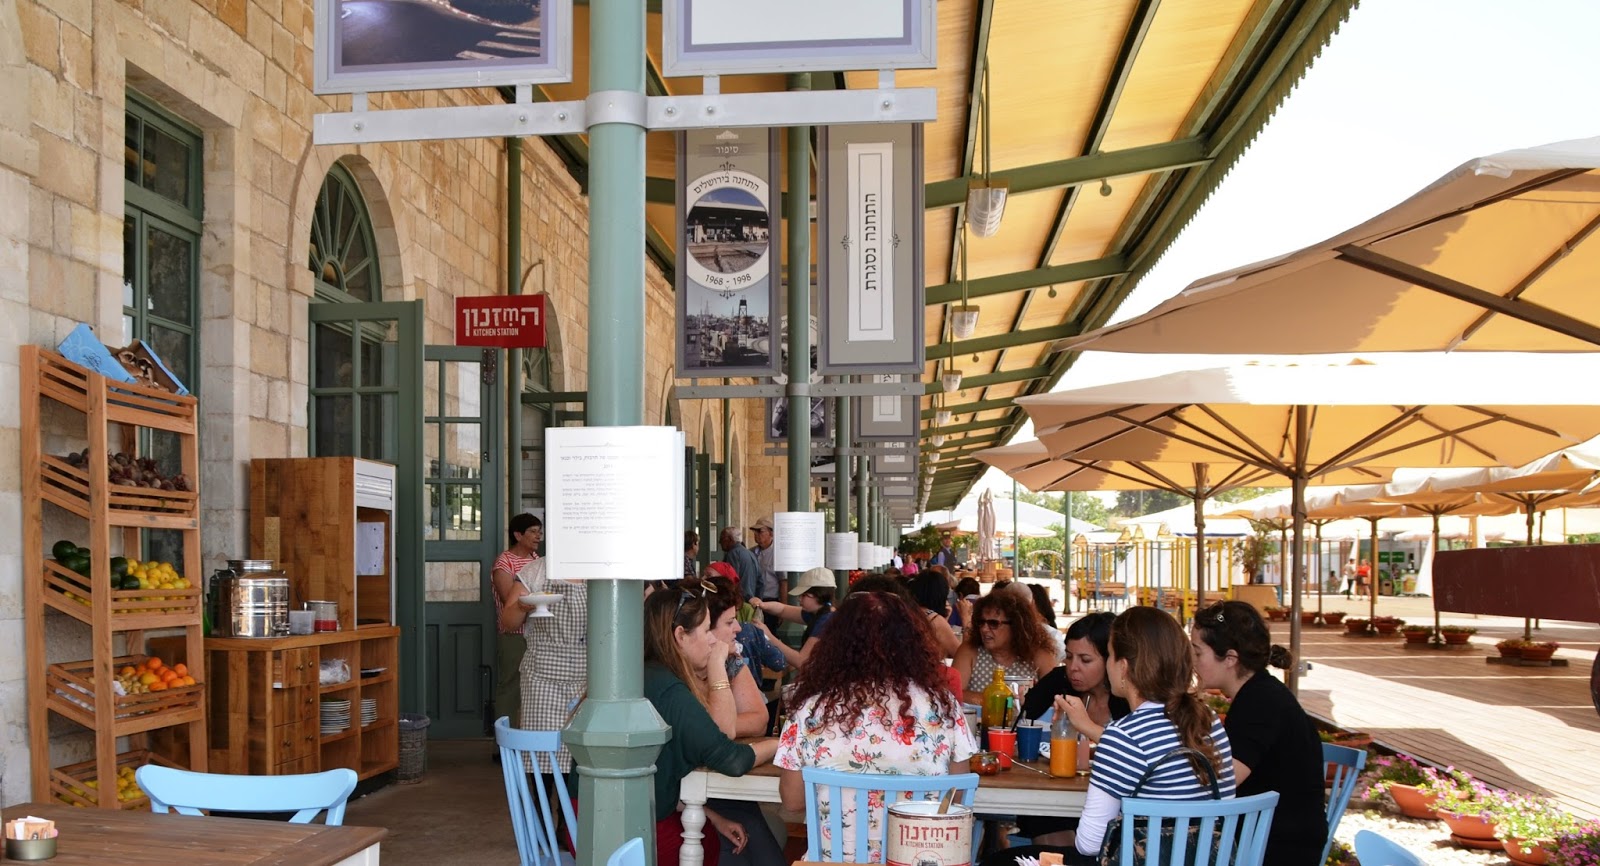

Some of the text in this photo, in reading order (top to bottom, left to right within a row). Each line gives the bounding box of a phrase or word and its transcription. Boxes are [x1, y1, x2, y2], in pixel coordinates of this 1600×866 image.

[715, 146, 739, 154] סיפור
[693, 175, 759, 194] התחנה בירושלים
[865, 193, 876, 291] התחנה נסגרת
[705, 274, 723, 285] 1968
[733, 273, 751, 285] 1998
[473, 328, 519, 336] KITCHEN STATION
